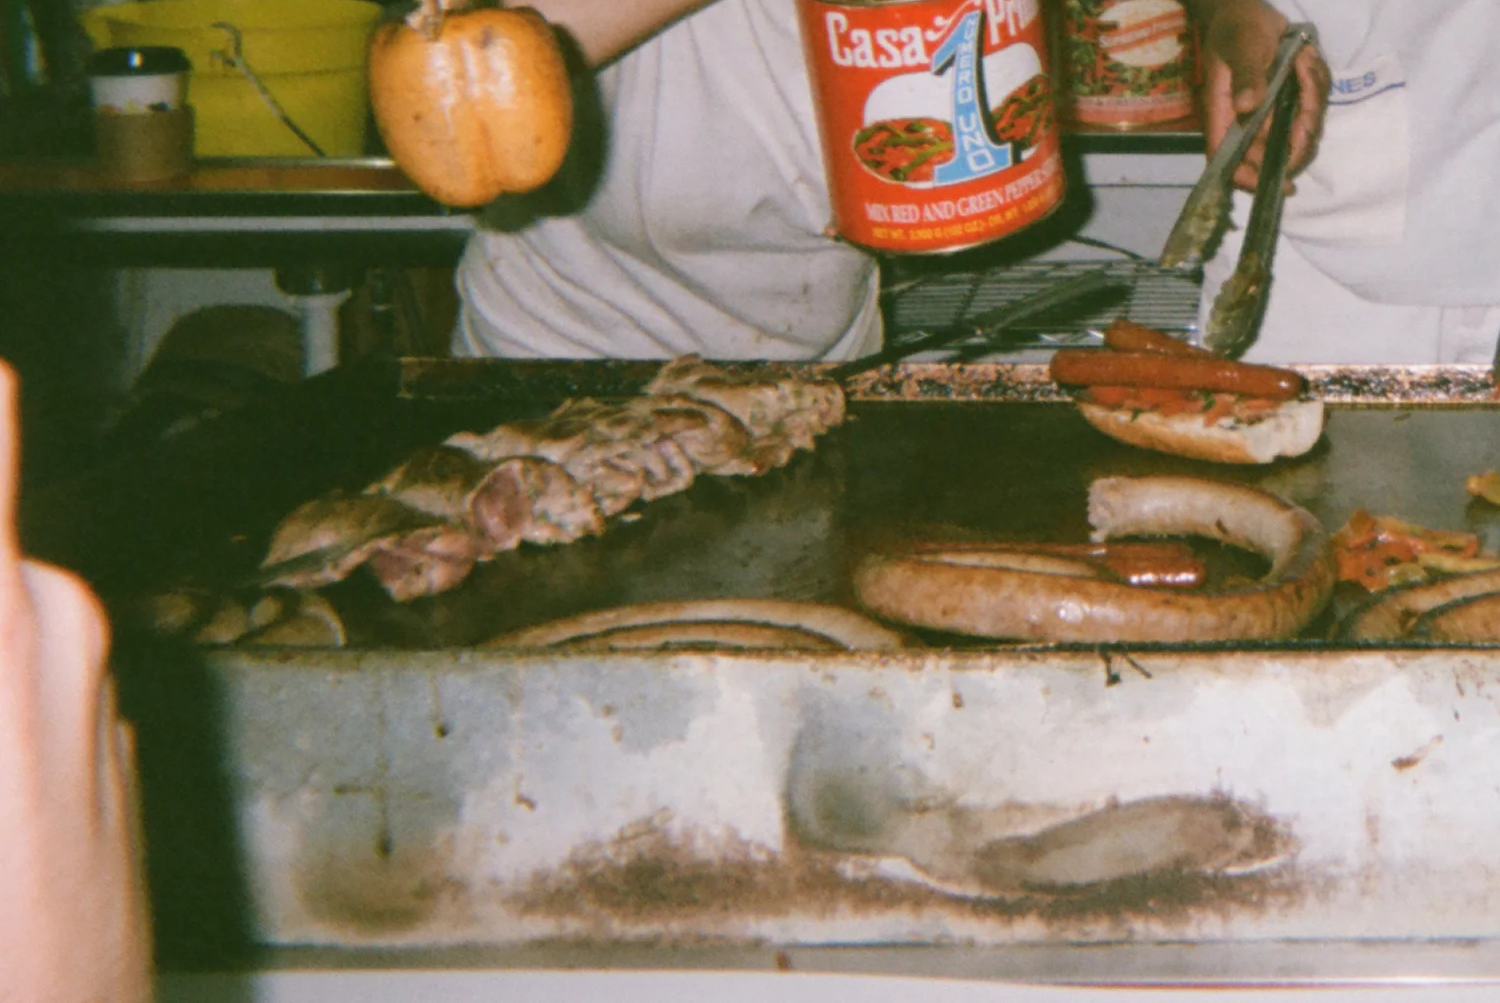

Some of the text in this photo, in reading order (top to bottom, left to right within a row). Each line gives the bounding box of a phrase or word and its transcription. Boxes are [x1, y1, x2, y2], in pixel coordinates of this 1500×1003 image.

[825, 10, 932, 68] Casa
[958, 112, 996, 172] UNO
[865, 202, 890, 223] MIX
[891, 204, 920, 224] RED
[922, 200, 956, 223] AND
[957, 188, 1005, 217] GREEN
